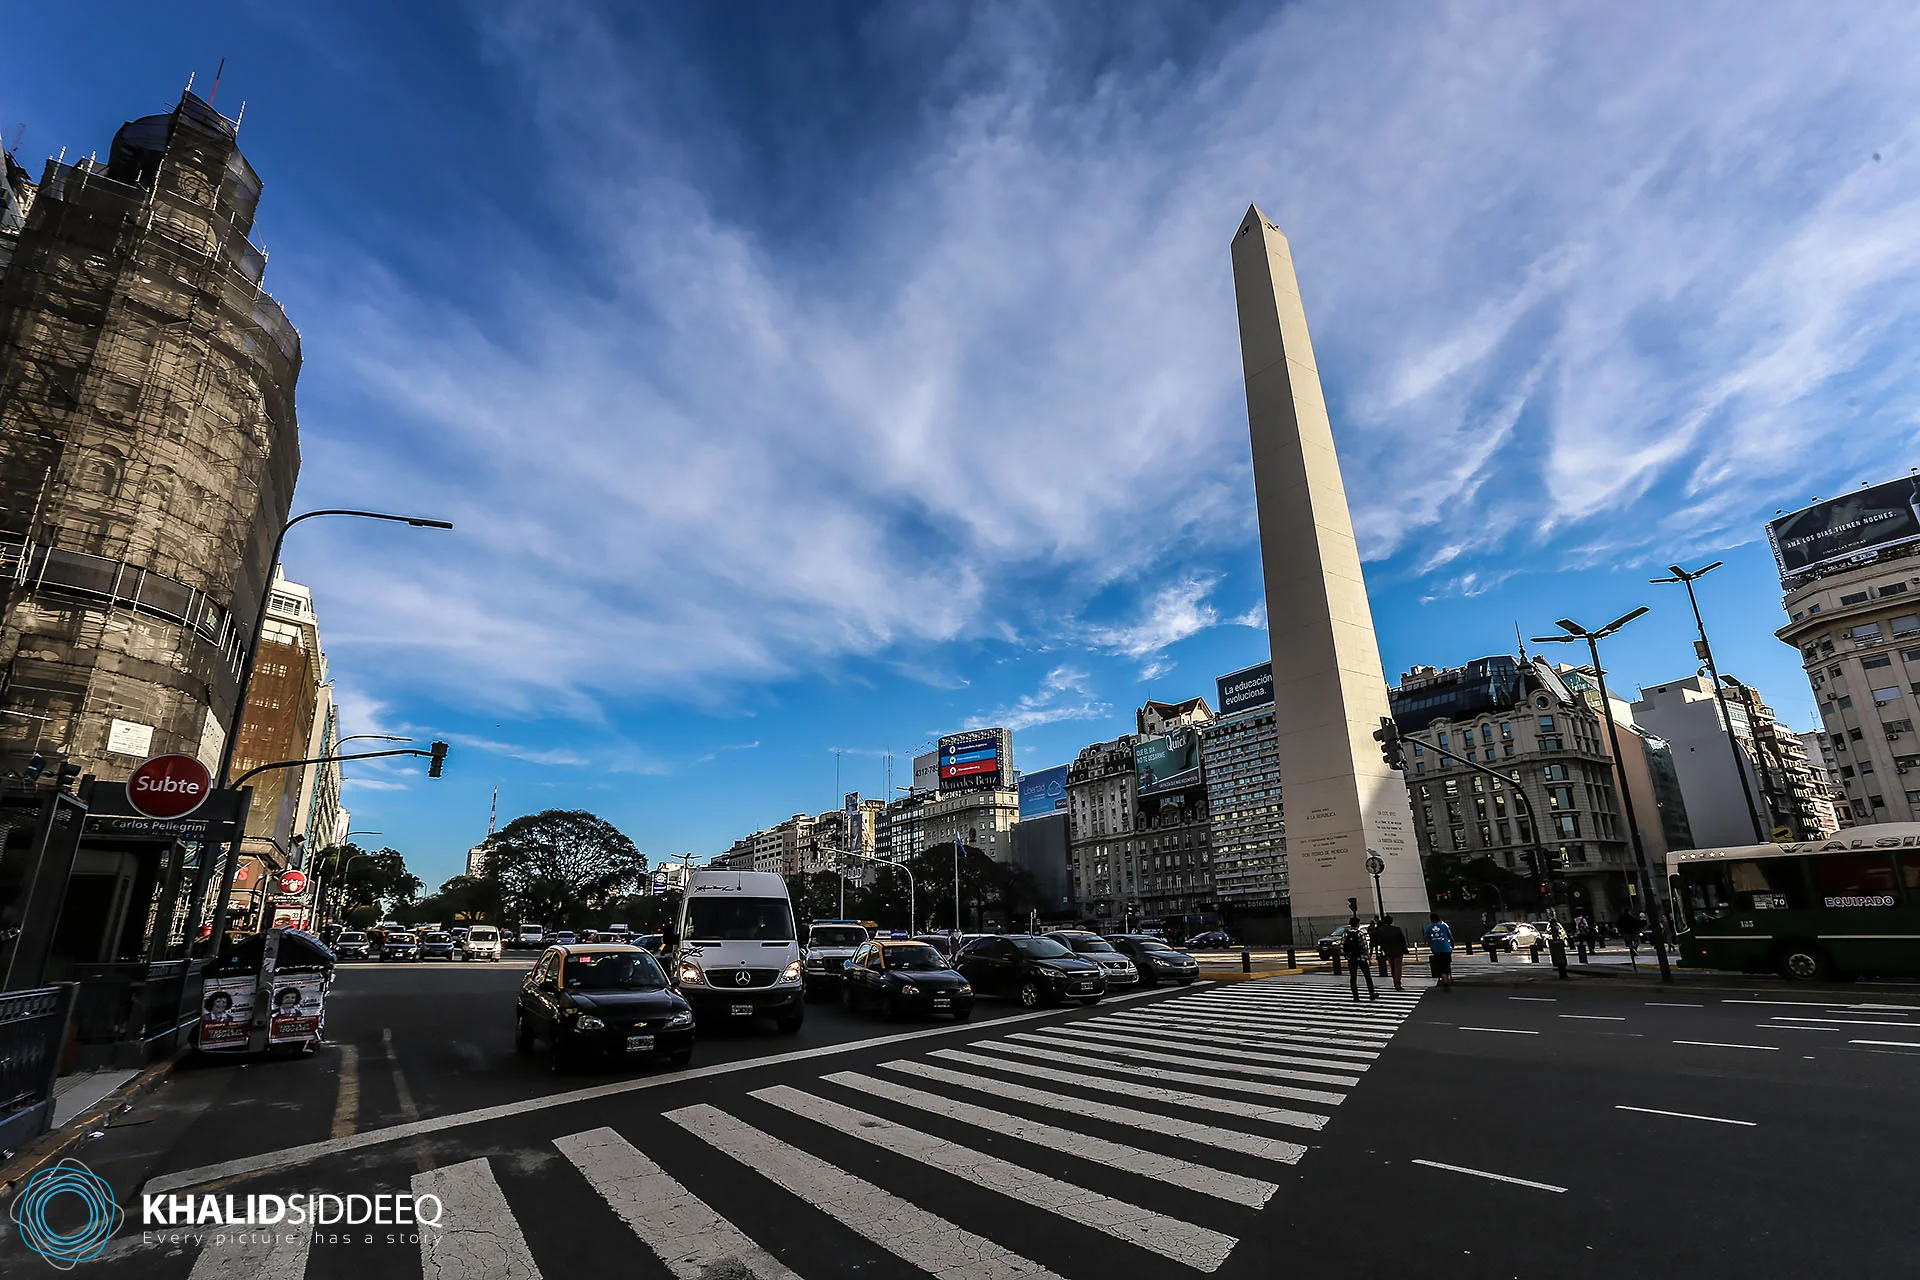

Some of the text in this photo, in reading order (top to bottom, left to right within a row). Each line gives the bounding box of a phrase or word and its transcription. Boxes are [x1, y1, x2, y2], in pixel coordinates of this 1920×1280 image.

[1224, 674, 1273, 696] La educación
[1226, 687, 1266, 706] evoluciona.
[136, 776, 200, 794] Subte
[112, 820, 206, 832] Carlos Pellegrini
[1819, 836, 1920, 852] ALSI
[1774, 898, 1785, 906] 70
[1824, 896, 1894, 907] EQUIPADO
